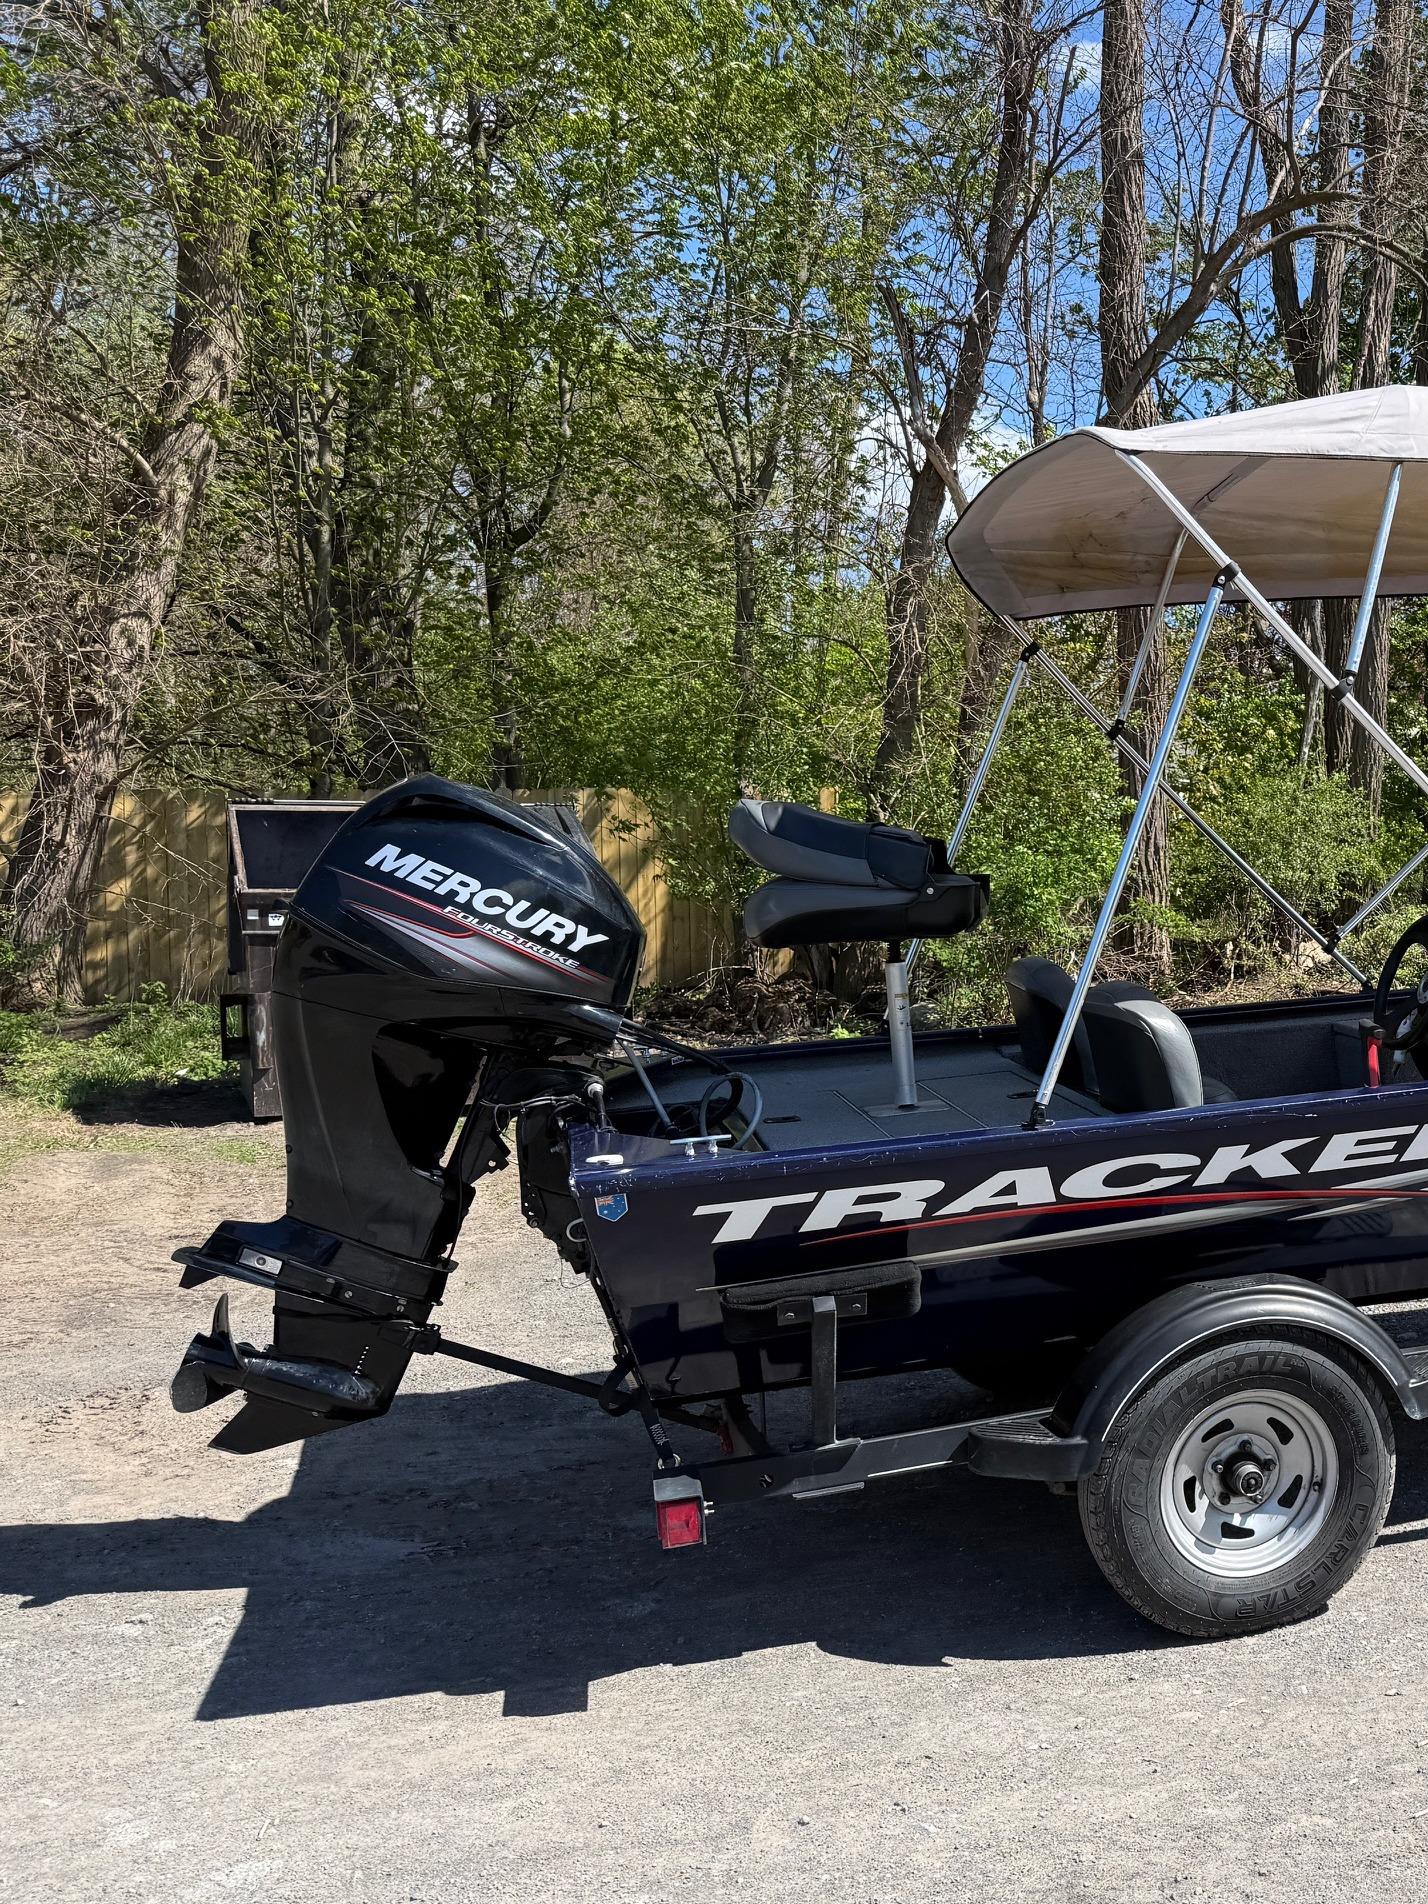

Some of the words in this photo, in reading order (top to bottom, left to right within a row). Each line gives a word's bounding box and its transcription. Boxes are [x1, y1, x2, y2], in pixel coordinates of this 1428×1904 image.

[364, 843, 610, 953] MERCURY
[442, 905, 582, 970] FOURSTROKE
[1196, 1354, 1294, 1390] TRAIL
[1235, 1502, 1374, 1619] CARLSTAR
